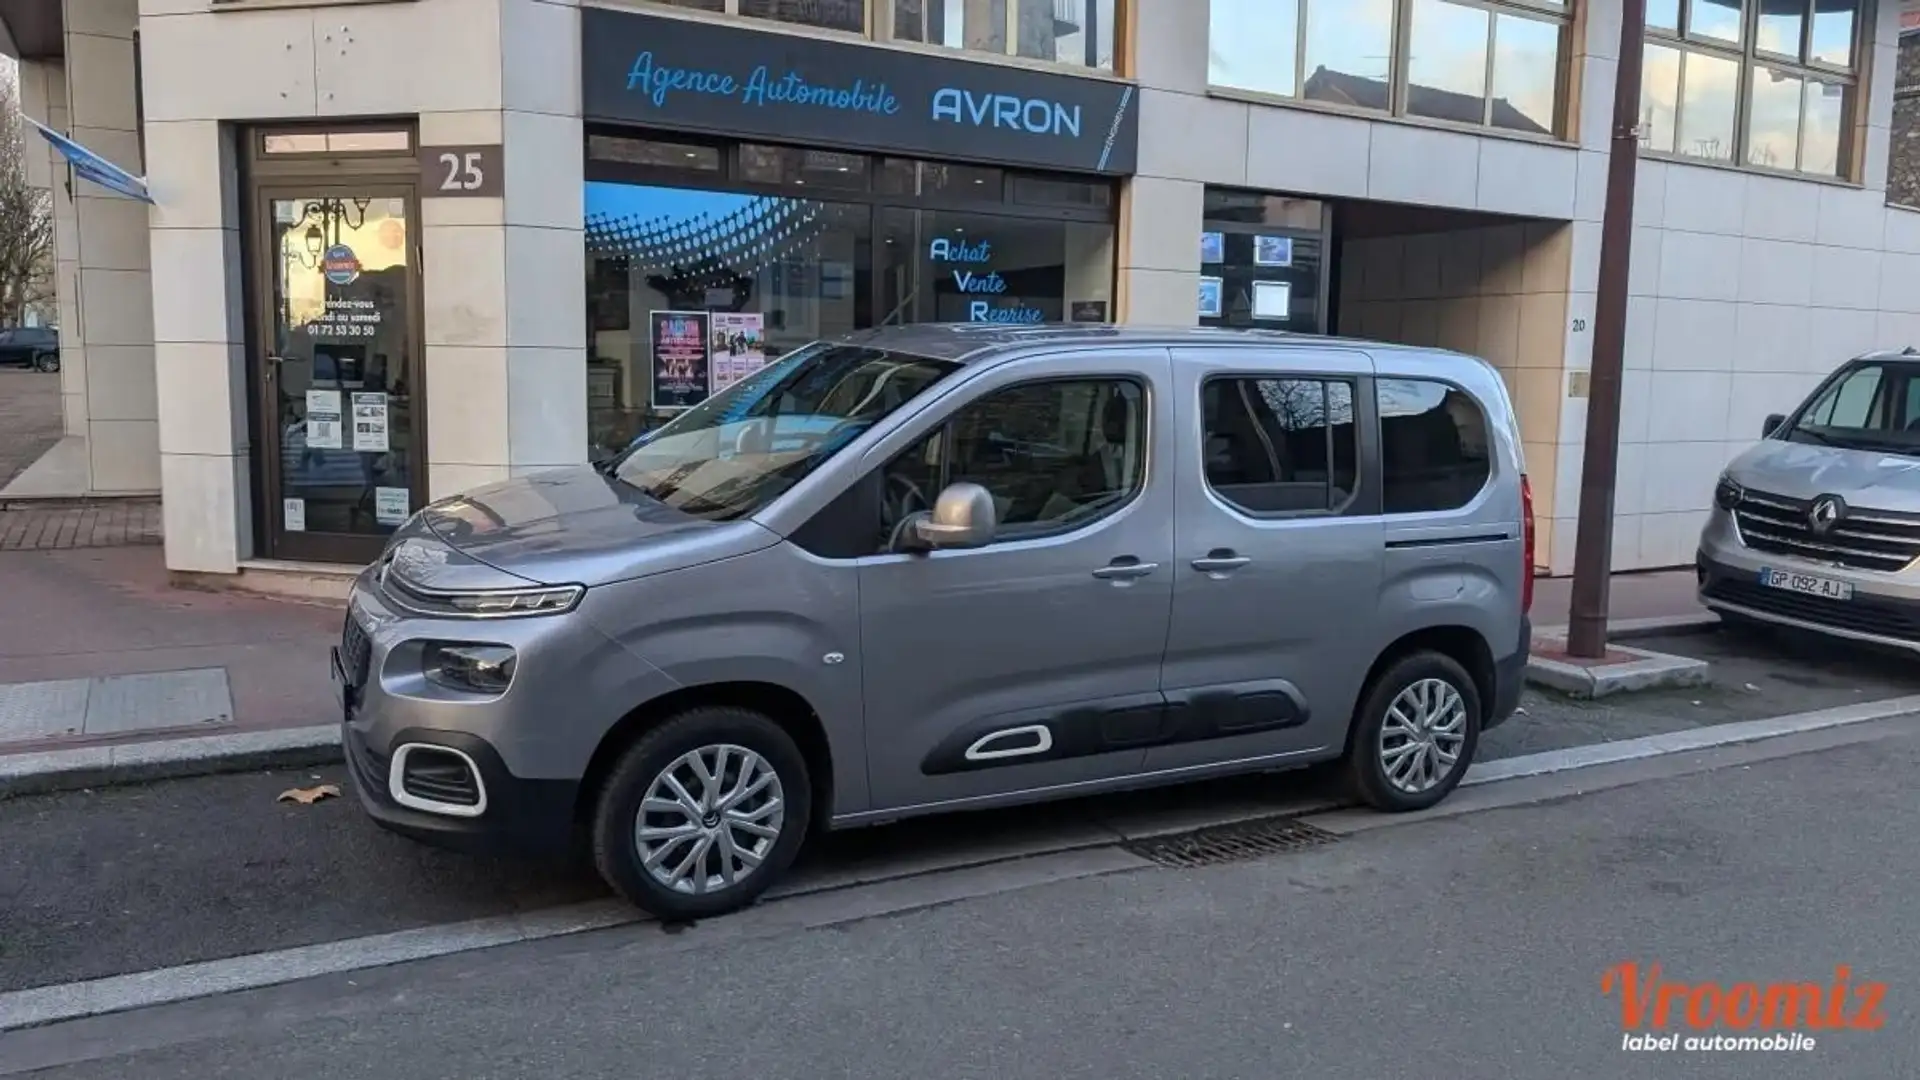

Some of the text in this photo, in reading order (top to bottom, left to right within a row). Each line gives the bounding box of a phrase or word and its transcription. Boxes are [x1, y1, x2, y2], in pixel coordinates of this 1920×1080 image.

[627, 51, 739, 107] Agence
[741, 66, 900, 114] Automobile
[932, 88, 1081, 138] AVRON
[440, 153, 483, 190] 25
[929, 238, 992, 262] Achat
[952, 269, 1008, 293] Vente
[970, 300, 1043, 323] Reprise
[307, 324, 319, 336] 01
[1573, 319, 1586, 332] 20
